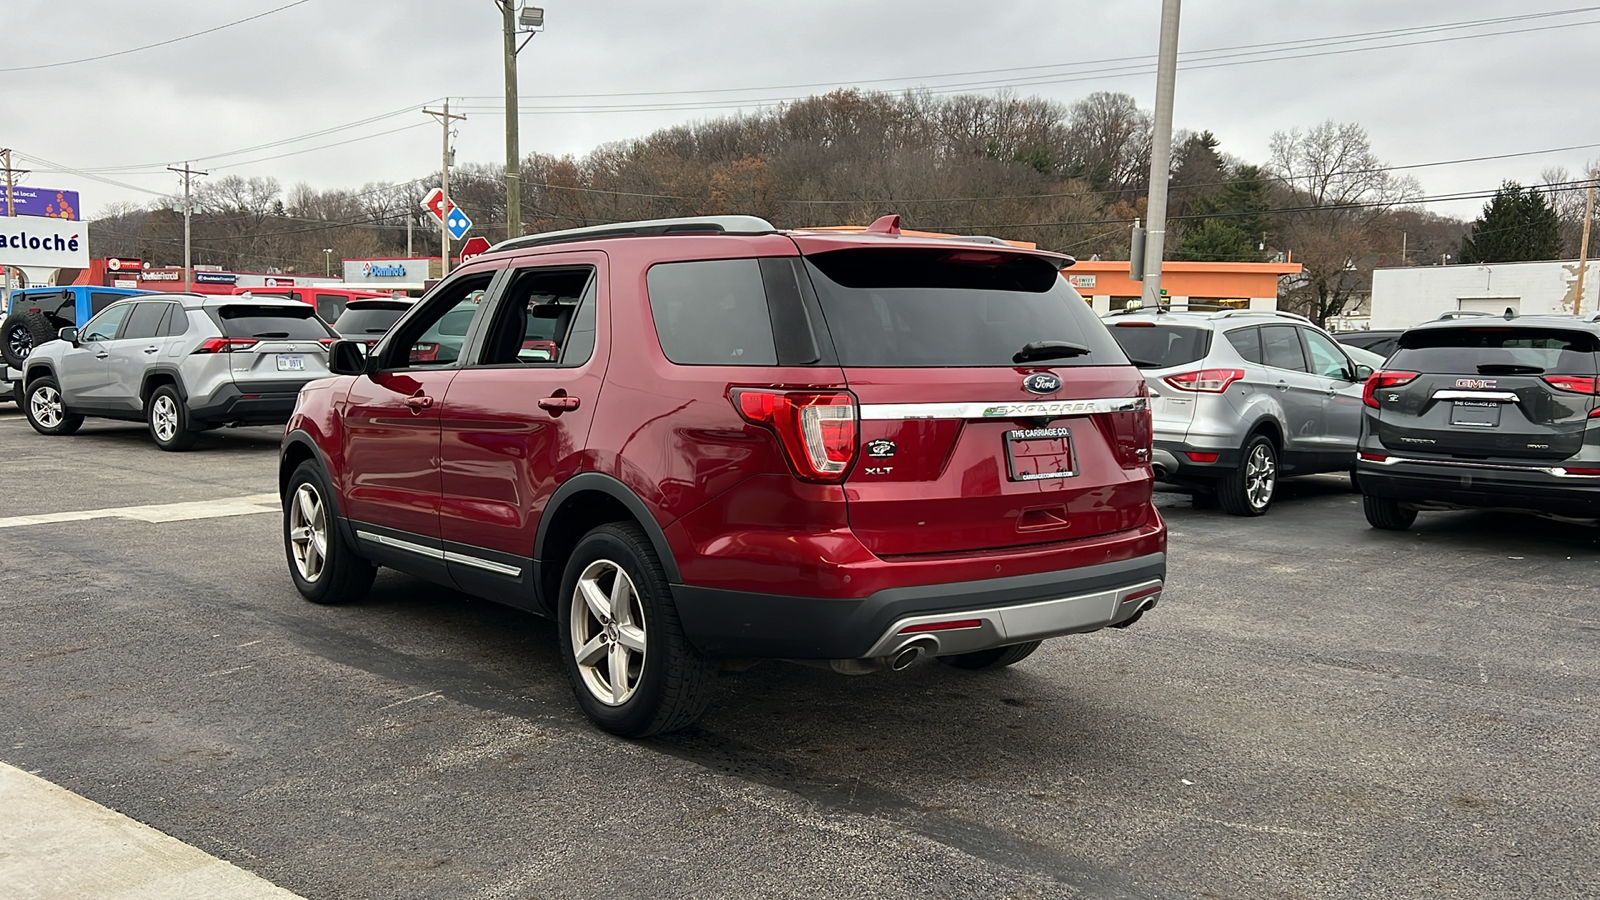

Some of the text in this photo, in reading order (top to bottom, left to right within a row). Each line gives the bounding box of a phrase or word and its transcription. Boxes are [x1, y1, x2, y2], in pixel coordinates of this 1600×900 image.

[0, 231, 79, 252] acloché
[371, 264, 406, 277] Domino's
[1034, 376, 1056, 389] Ford
[1456, 379, 1497, 389] GMC
[995, 402, 1096, 414] EXPLORER
[1011, 427, 1069, 438] THE CARRIAGE CO.
[864, 466, 894, 475] XLT
